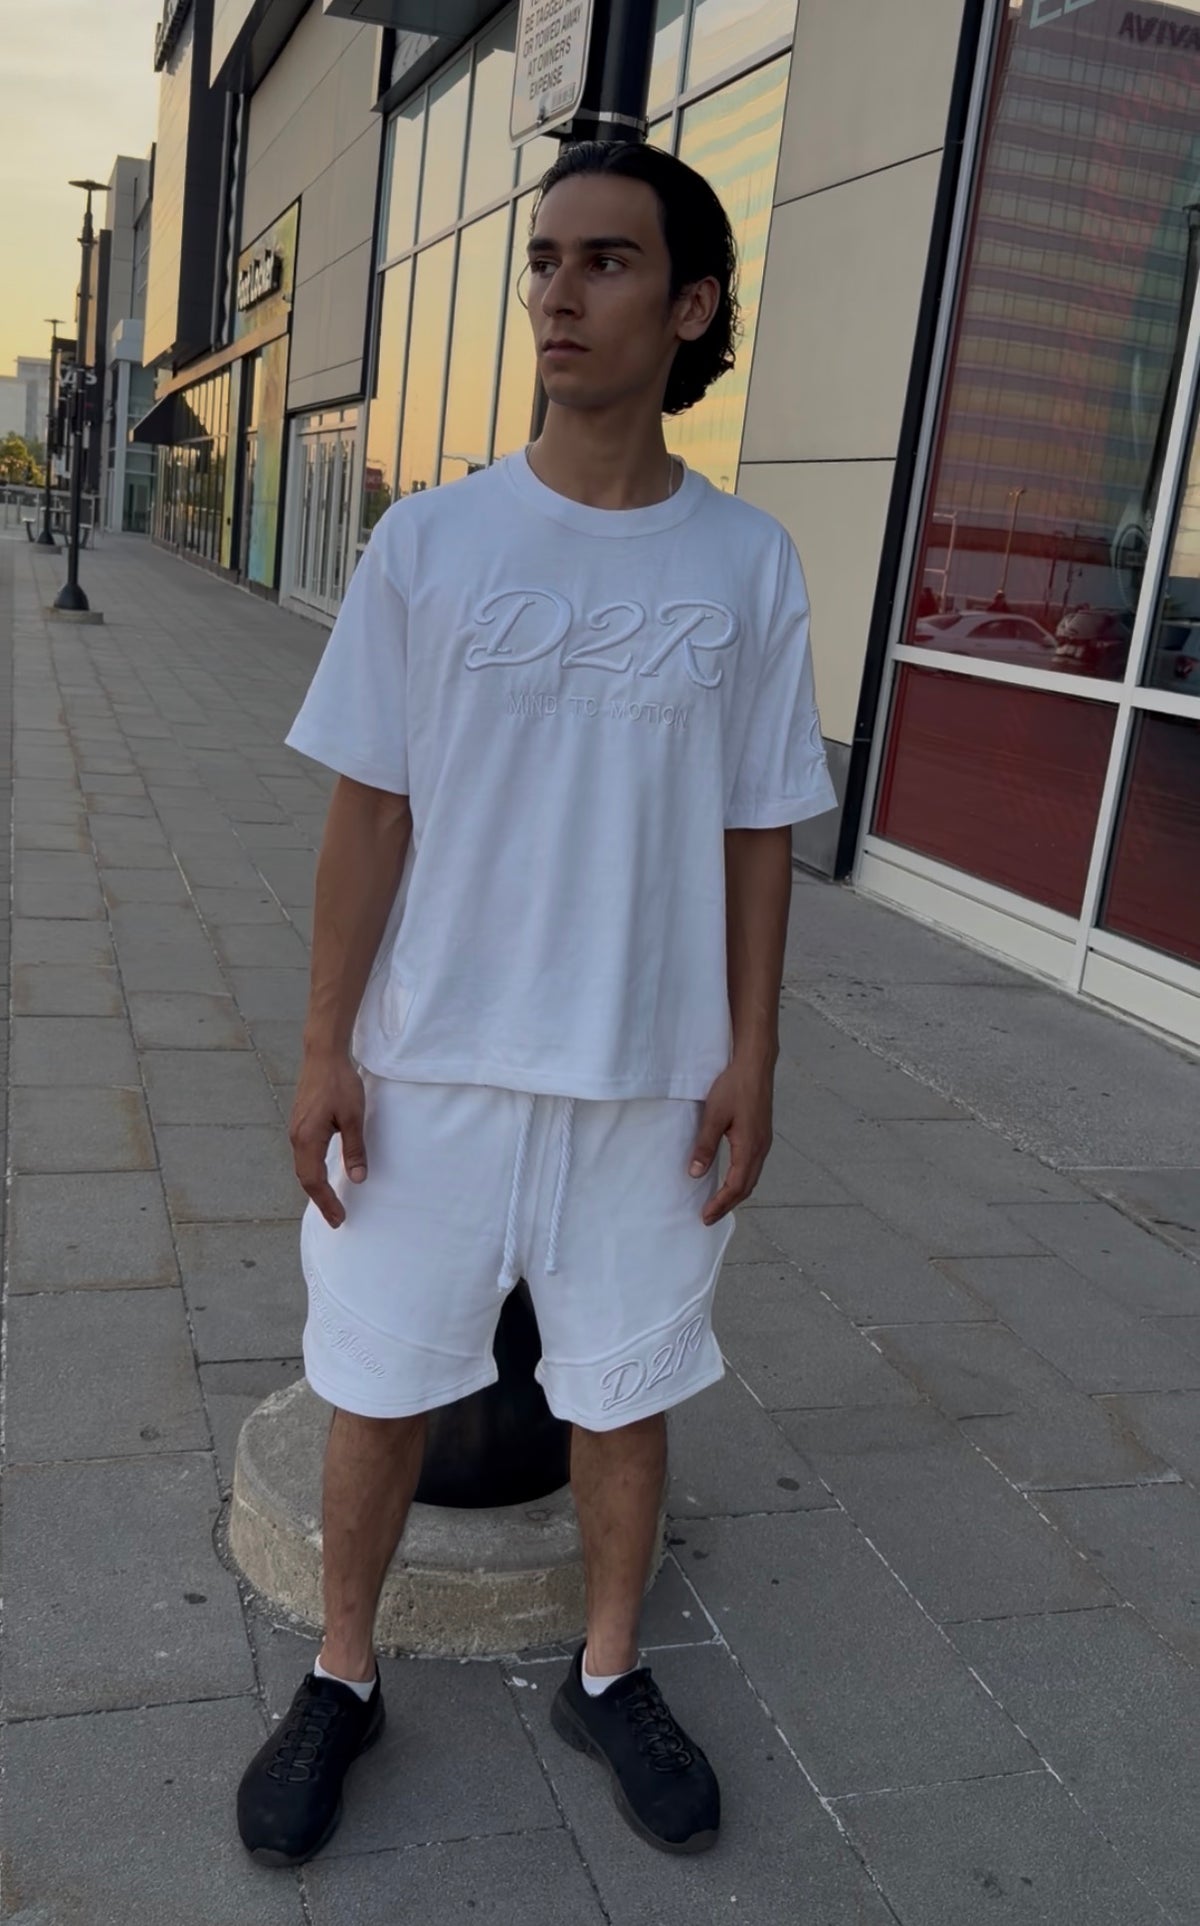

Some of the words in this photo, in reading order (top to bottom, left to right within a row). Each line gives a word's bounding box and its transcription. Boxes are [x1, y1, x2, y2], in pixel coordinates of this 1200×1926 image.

[523, 37, 534, 58] OR
[534, 18, 560, 51] TOWED
[561, 3, 582, 33] AWAY
[524, 12, 535, 34] BE
[527, 57, 538, 78] AT
[529, 65, 564, 100] EXPENSE
[465, 588, 741, 690] D2R
[508, 694, 558, 717] MIND
[568, 696, 600, 718] TO
[609, 700, 690, 729] MOTION
